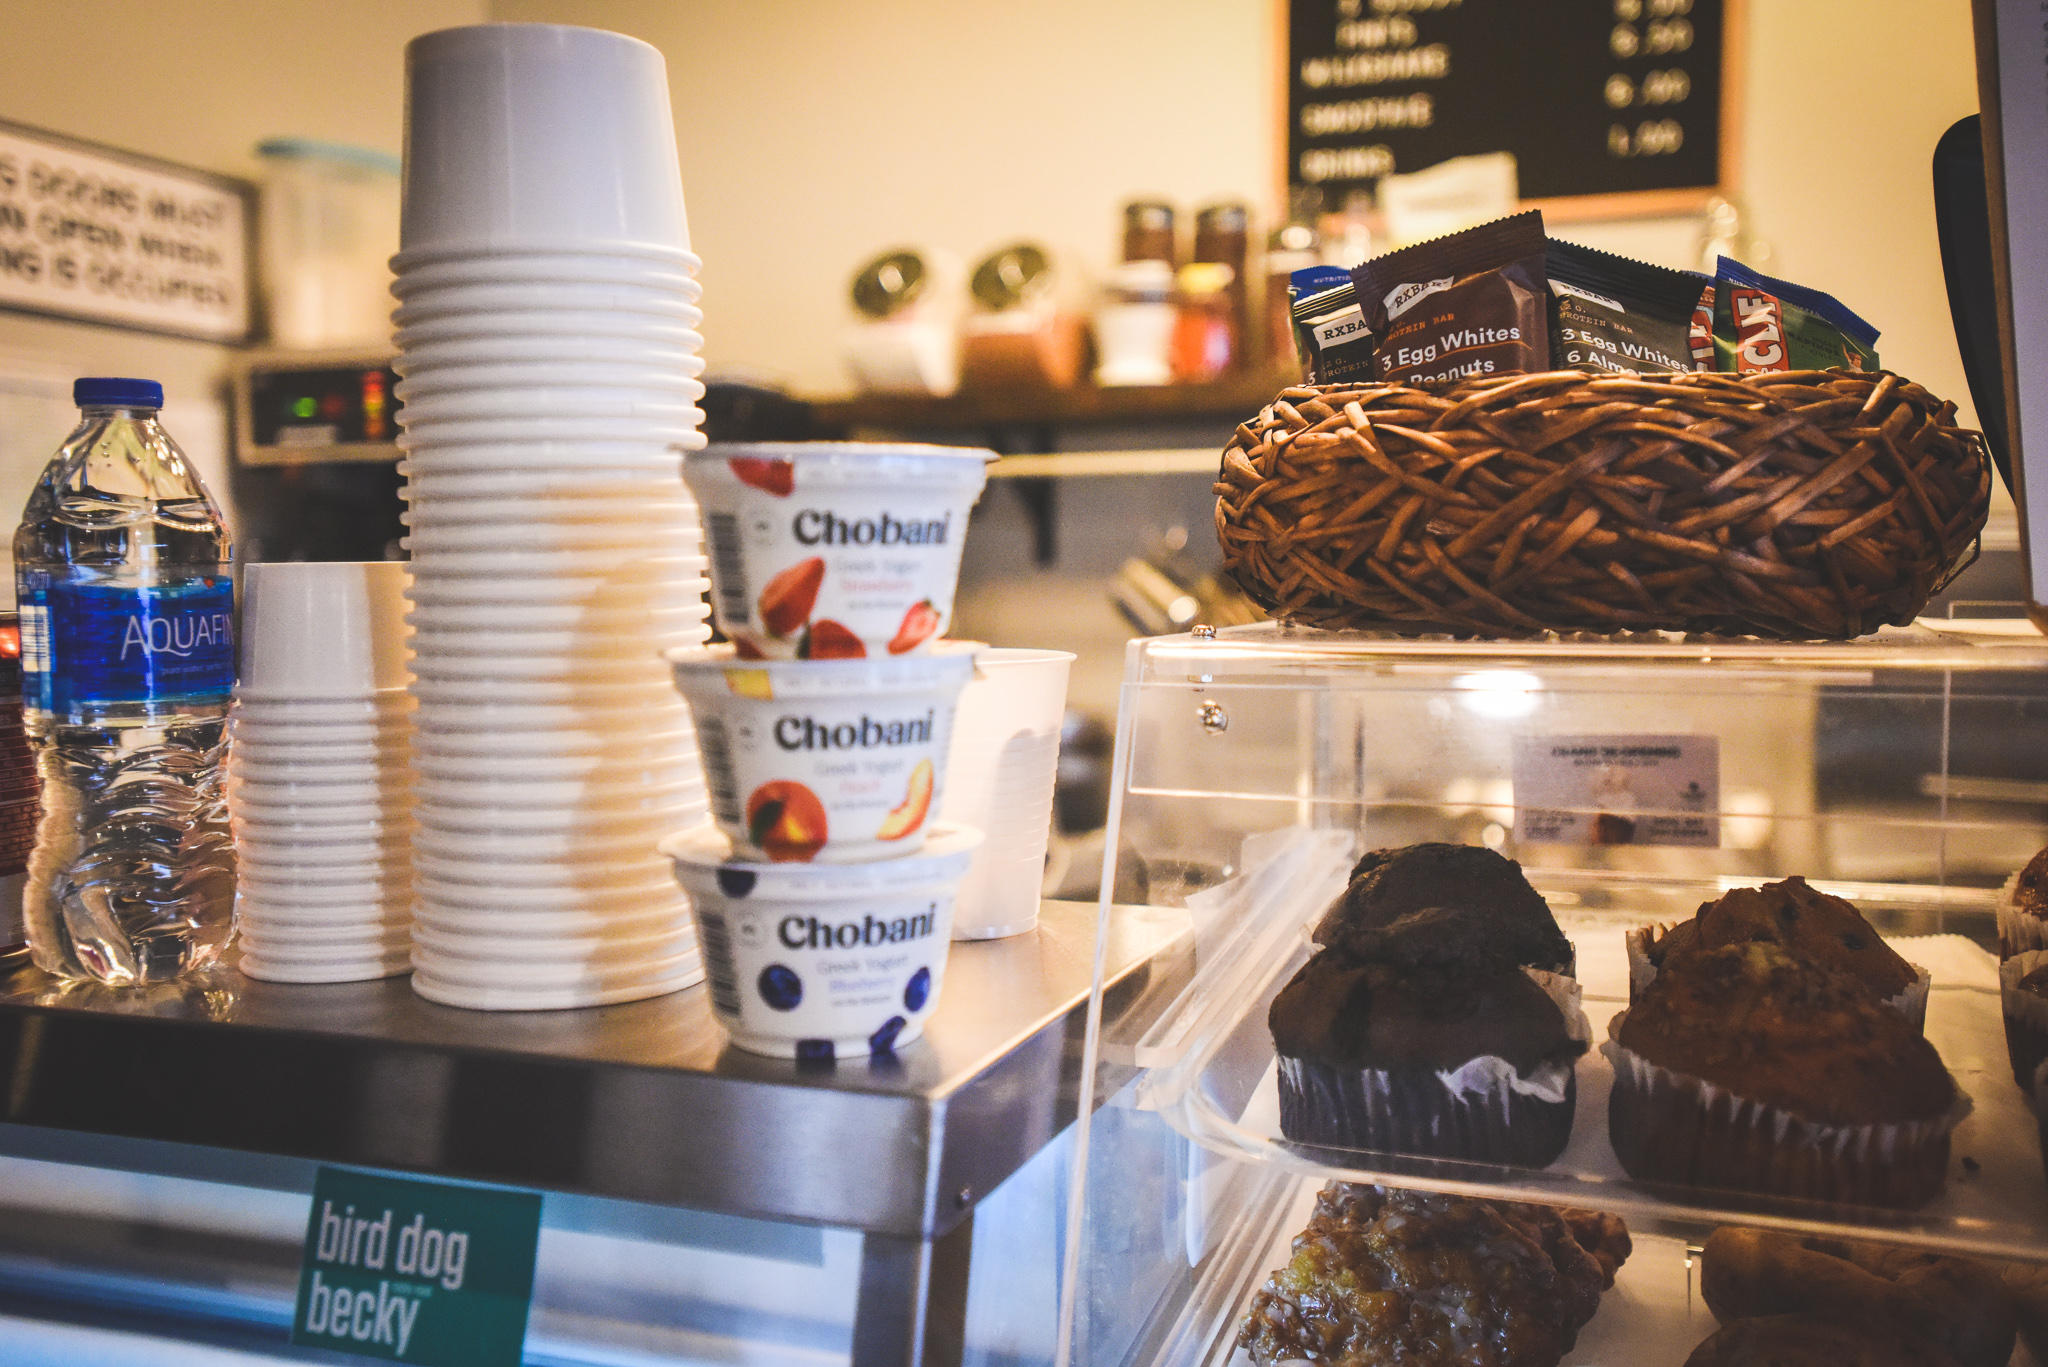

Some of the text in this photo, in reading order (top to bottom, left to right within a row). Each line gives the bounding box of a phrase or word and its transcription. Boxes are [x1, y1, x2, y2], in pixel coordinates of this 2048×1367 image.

[28, 162, 137, 217] DOORS
[36, 205, 125, 250] OPEN
[54, 253, 78, 287] IS
[1381, 326, 1521, 372] 3 Egg Whites
[1385, 320, 1426, 341] ROTEIN
[1562, 328, 1575, 341] 3
[1581, 330, 1617, 354] Egg
[1622, 340, 1689, 374] Whites
[1737, 297, 1784, 366] CLIF
[1567, 350, 1581, 363] 6
[792, 508, 951, 546] Chobani
[774, 709, 933, 750] Chobani
[777, 903, 937, 950] Chobani
[317, 1201, 469, 1290] bird dog
[305, 1271, 421, 1358] becky
